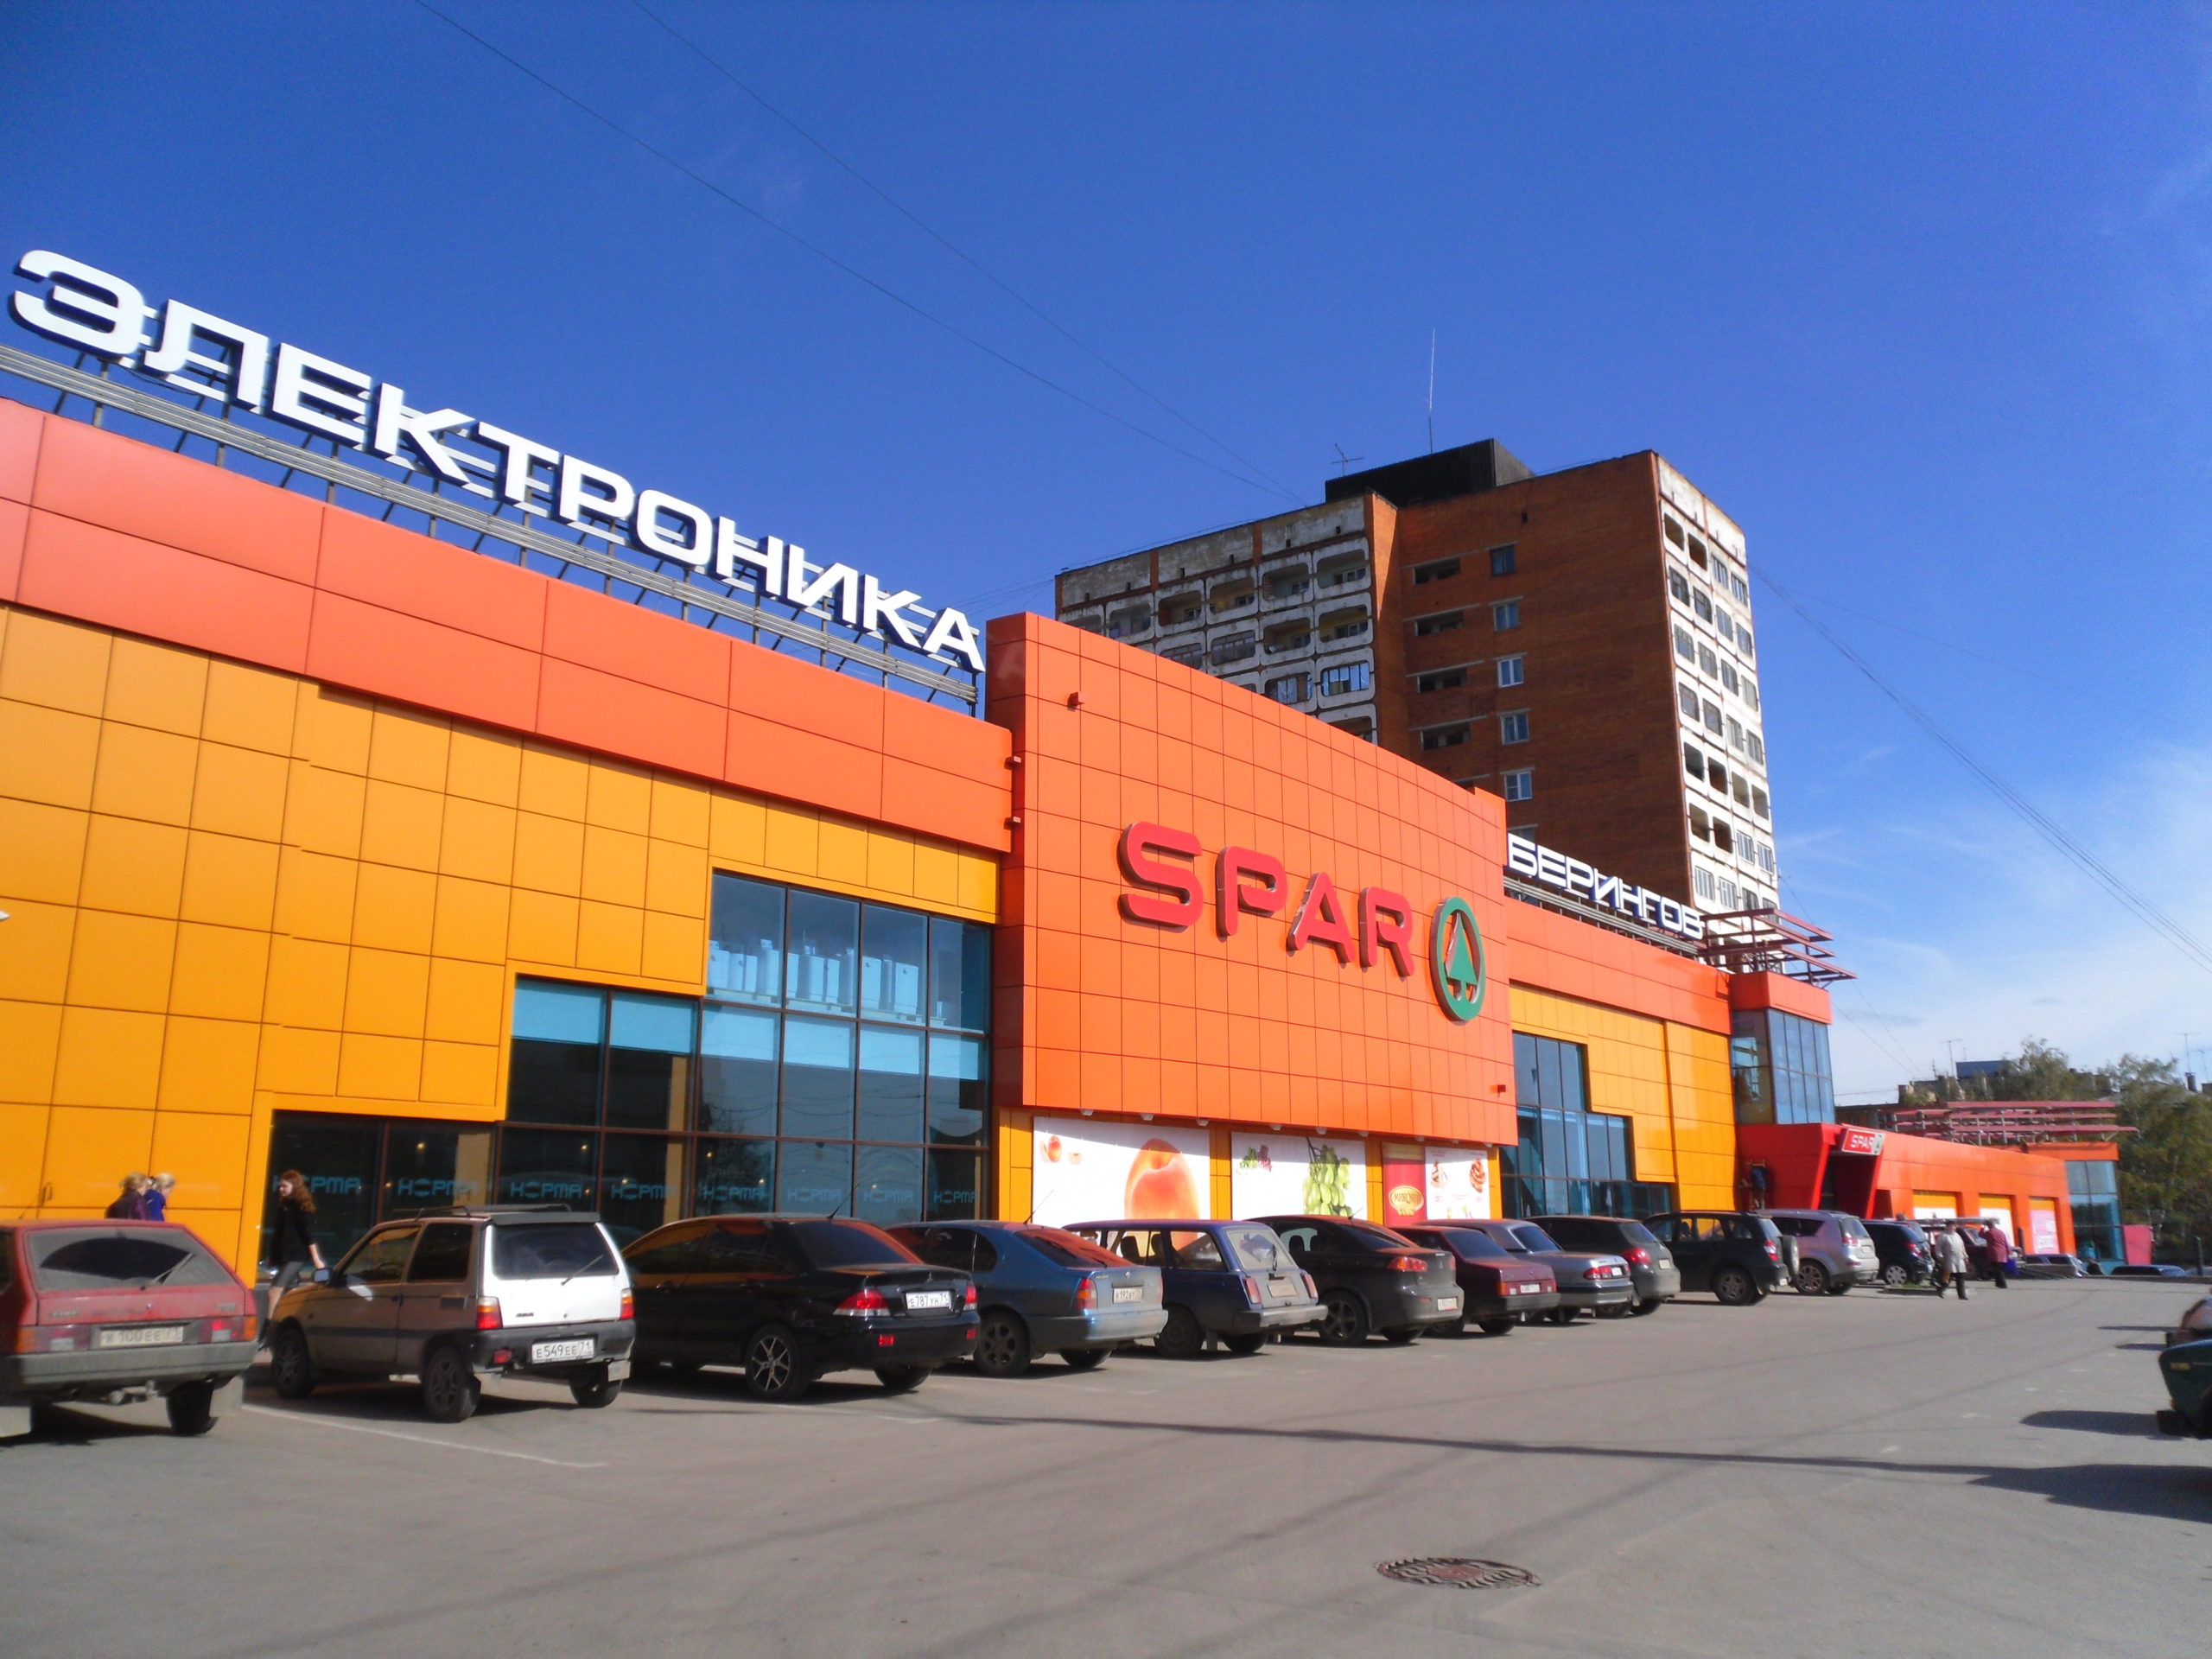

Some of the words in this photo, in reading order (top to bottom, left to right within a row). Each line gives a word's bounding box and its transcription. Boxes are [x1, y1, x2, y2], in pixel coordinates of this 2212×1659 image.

[12, 250, 986, 674] ЭЛЕКТРОНИКА
[1118, 821, 1415, 978] SPAR
[1506, 832, 1704, 941] БЕРИНГОВ
